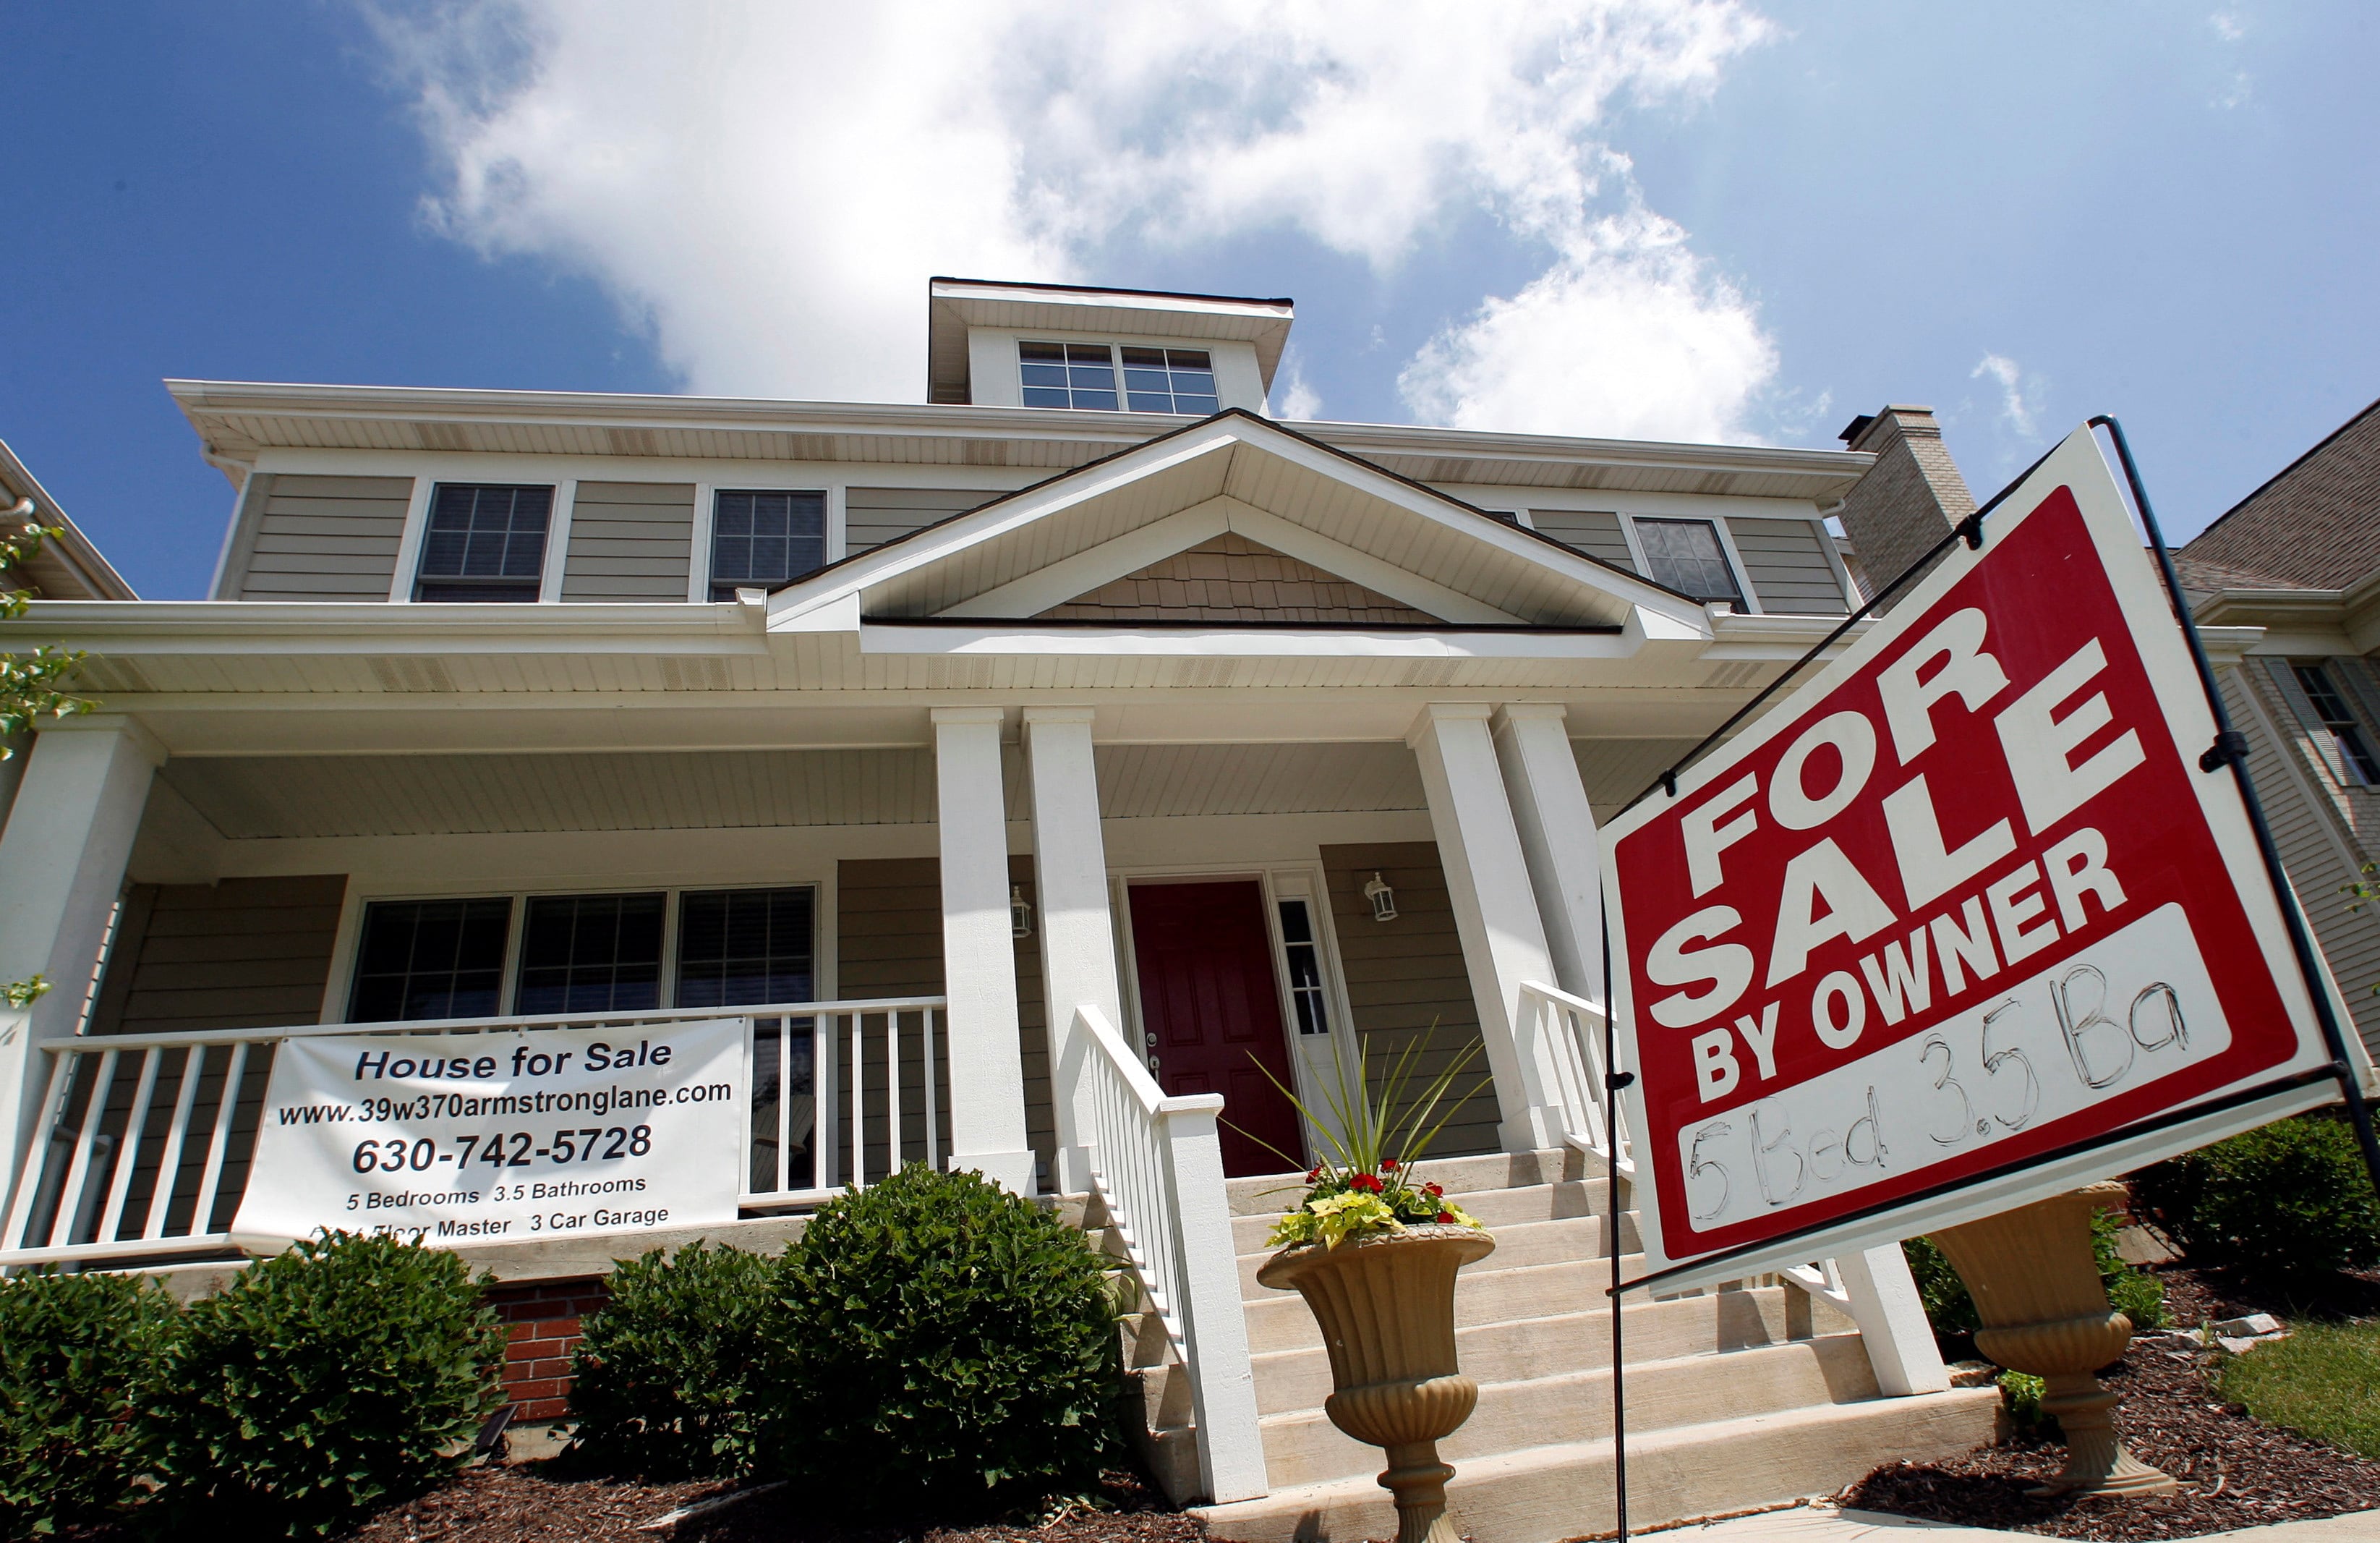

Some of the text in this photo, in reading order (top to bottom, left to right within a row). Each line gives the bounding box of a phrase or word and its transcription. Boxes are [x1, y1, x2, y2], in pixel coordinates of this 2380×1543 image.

[1681, 607, 2011, 900] FOR
[1646, 636, 2146, 1029] SALE
[1691, 827, 2128, 1104] BY OWNER
[354, 1040, 672, 1081] House for Sale
[279, 1084, 731, 1126] www.39w370armstronglane.com
[1689, 964, 2189, 1220] 5 Bed 3.5 Ba
[353, 1124, 652, 1174] 630-742-5728
[346, 1178, 646, 1210] 5 Bedrooms 3.5 Bathrooms
[438, 1217, 511, 1236] Master
[531, 1215, 542, 1231] 3
[550, 1212, 587, 1230] Car
[594, 1207, 669, 1227] Garage
